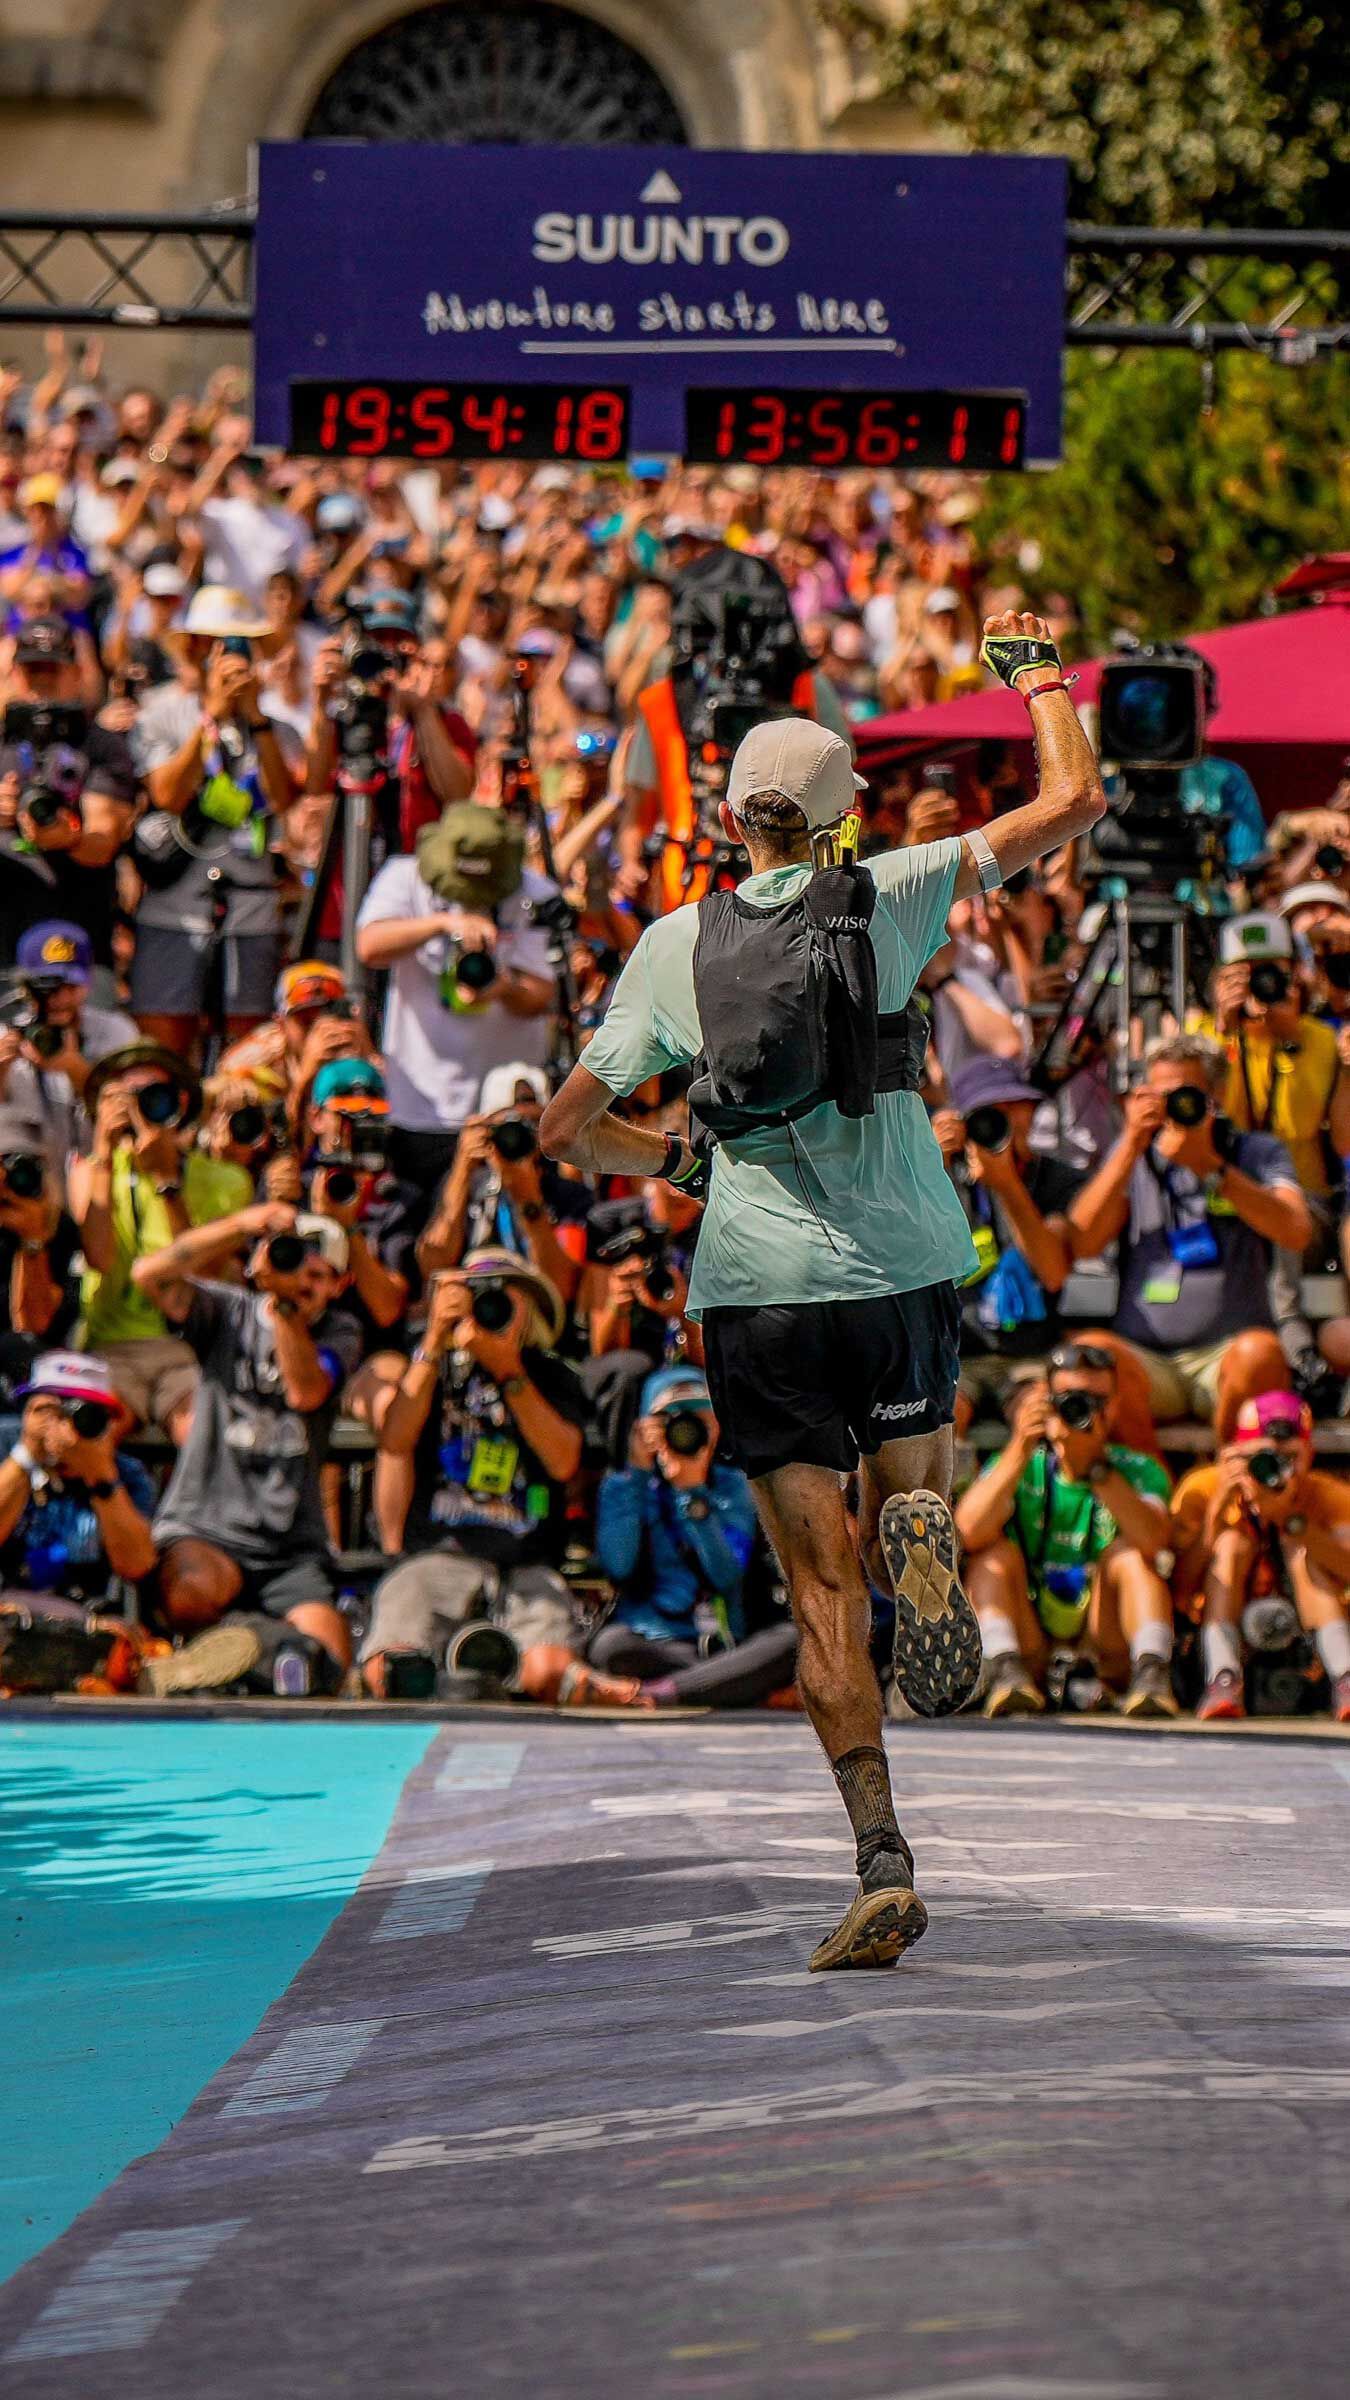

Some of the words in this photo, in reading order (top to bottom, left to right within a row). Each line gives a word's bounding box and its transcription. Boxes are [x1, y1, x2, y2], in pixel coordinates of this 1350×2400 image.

[532, 212, 791, 267] SUUNTO
[320, 387, 624, 460] 19:54:18
[986, 644, 1012, 661] LEKI
[870, 1398, 928, 1421] HOKA
